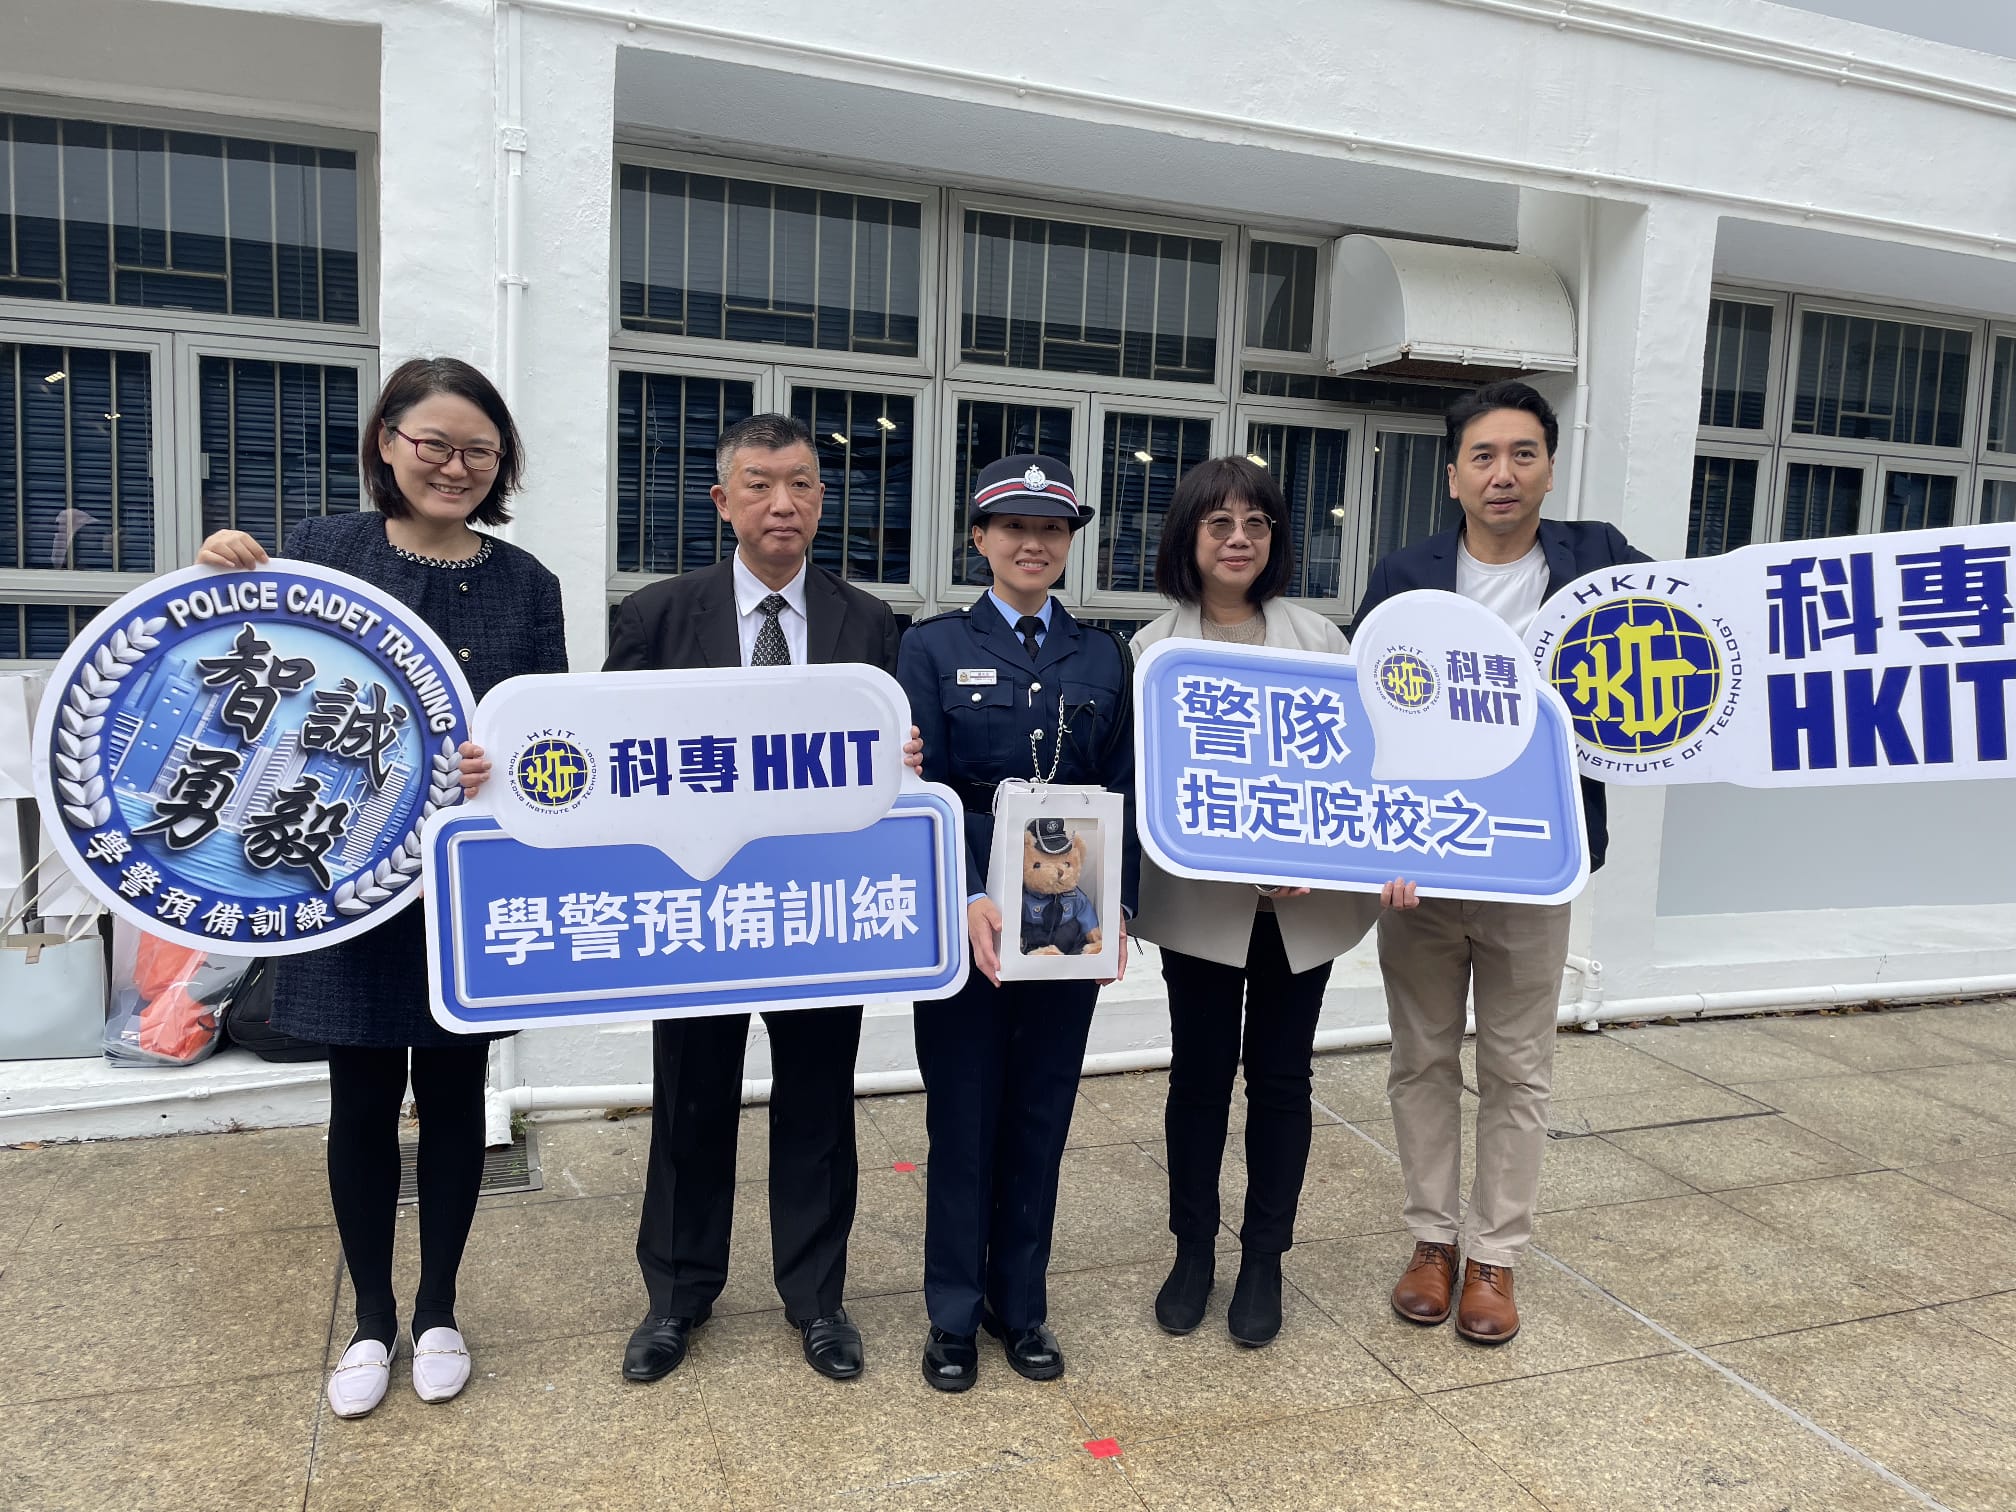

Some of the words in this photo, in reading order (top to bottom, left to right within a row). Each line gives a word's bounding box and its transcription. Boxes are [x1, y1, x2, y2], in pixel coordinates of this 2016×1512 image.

[1573, 574, 1690, 604] HKIT
[1766, 544, 2014, 660] 科專
[167, 581, 279, 628] POLICE
[287, 584, 382, 637] CADET
[377, 624, 457, 734] TRAINING
[1386, 645, 1423, 655] HKIT
[1446, 650, 1518, 689] 科專
[1448, 687, 1521, 726] HKIT
[1682, 740, 1703, 760] OF
[1705, 617, 1743, 738] TECHNOLOGY
[1767, 659, 2016, 772] HKIT
[526, 728, 576, 742] HKIT
[1177, 676, 1347, 768] 警隊
[508, 751, 519, 776] HONG
[581, 748, 597, 800] TECHNOLOGY
[609, 735, 739, 797] 科專
[751, 729, 880, 792] HKIT
[509, 780, 525, 802] KONG
[525, 801, 569, 815] INSTITUTE
[571, 800, 582, 810] OF
[1179, 771, 1549, 856] 指定院校之一
[86, 828, 336, 937] 學警預備訓練
[484, 873, 919, 966] 學警預備訓練
